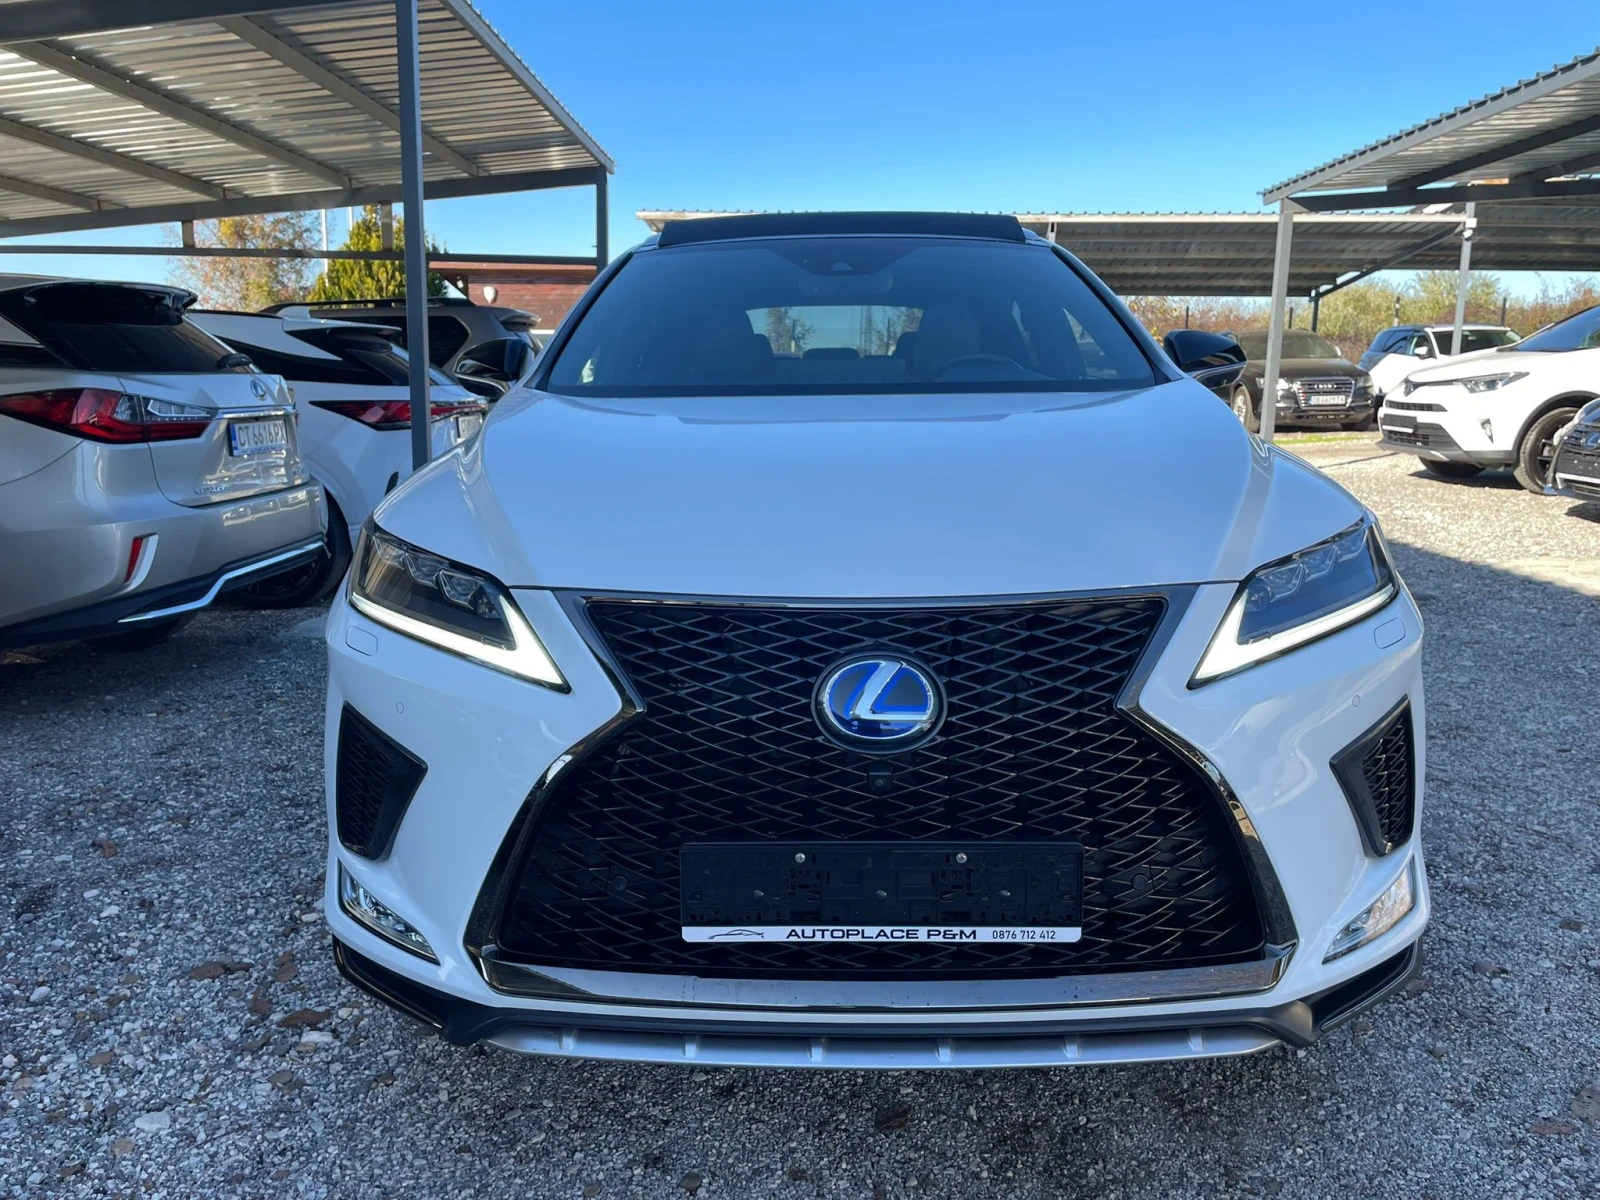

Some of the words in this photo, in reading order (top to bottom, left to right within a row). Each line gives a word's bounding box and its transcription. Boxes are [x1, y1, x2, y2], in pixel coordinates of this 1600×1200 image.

[238, 425, 250, 447] CT
[786, 929, 919, 939] AUTOPLACE
[927, 929, 977, 940] P&M
[992, 930, 1017, 940] 0876
[1020, 930, 1036, 940] 712
[1039, 930, 1056, 940] 412
